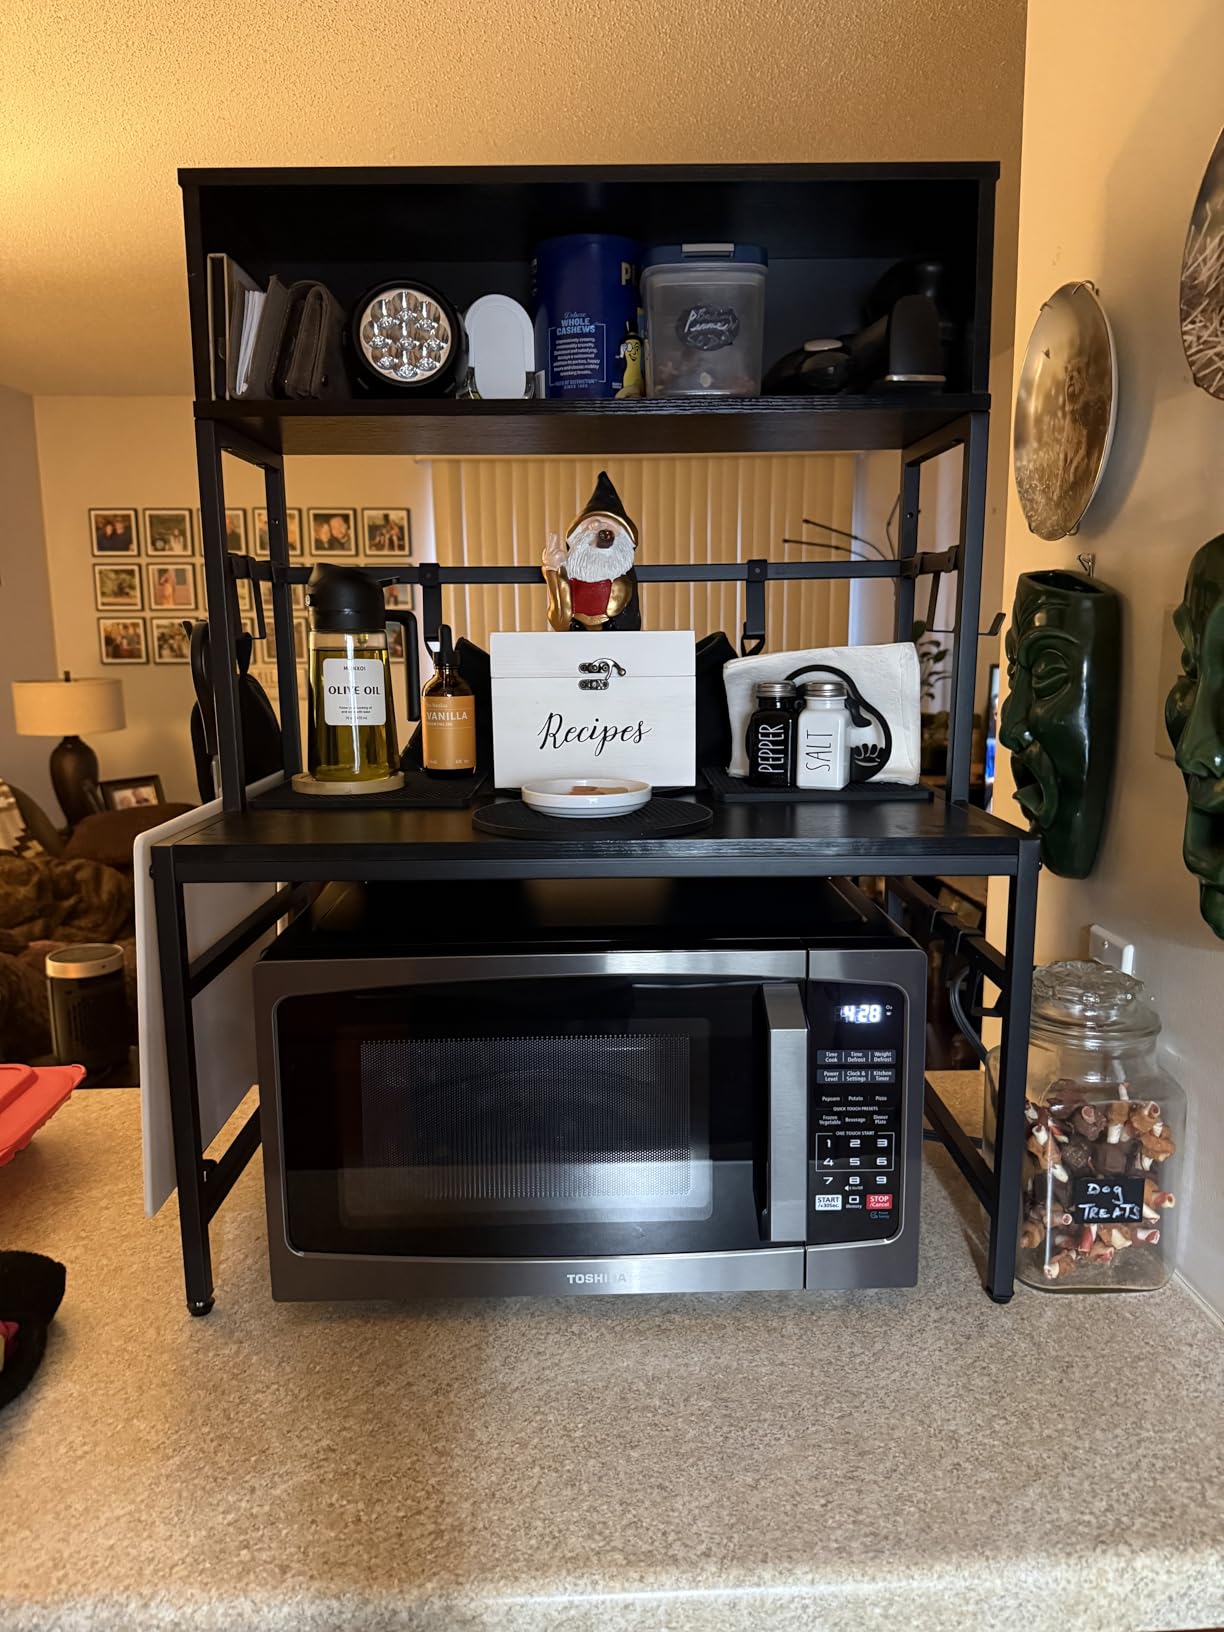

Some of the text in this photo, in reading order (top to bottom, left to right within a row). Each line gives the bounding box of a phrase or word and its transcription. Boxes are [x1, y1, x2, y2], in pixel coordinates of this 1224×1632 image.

[561, 317, 590, 327] WHOLE
[556, 325, 596, 336] CASHEWS
[328, 685, 381, 695] OLIVE OIL
[426, 711, 468, 721] VANILLA
[537, 712, 652, 757] Recipes
[758, 724, 785, 774] PEPPER
[805, 729, 834, 772] SALT
[826, 1138, 831, 1148] 1
[849, 1139, 861, 1148] 2
[876, 1138, 888, 1148] 3
[823, 1157, 834, 1167] 4
[849, 1157, 860, 1166] 5
[876, 1157, 887, 1166] 6
[823, 1176, 834, 1185] 7
[849, 1176, 860, 1185] 8
[876, 1176, 887, 1184] 9
[870, 1195, 889, 1203] STOP
[1087, 1183, 1124, 1205] Dog
[849, 1195, 860, 1204] 0
[1078, 1203, 1141, 1220] TREATS
[566, 1273, 627, 1284] TOSHIA
